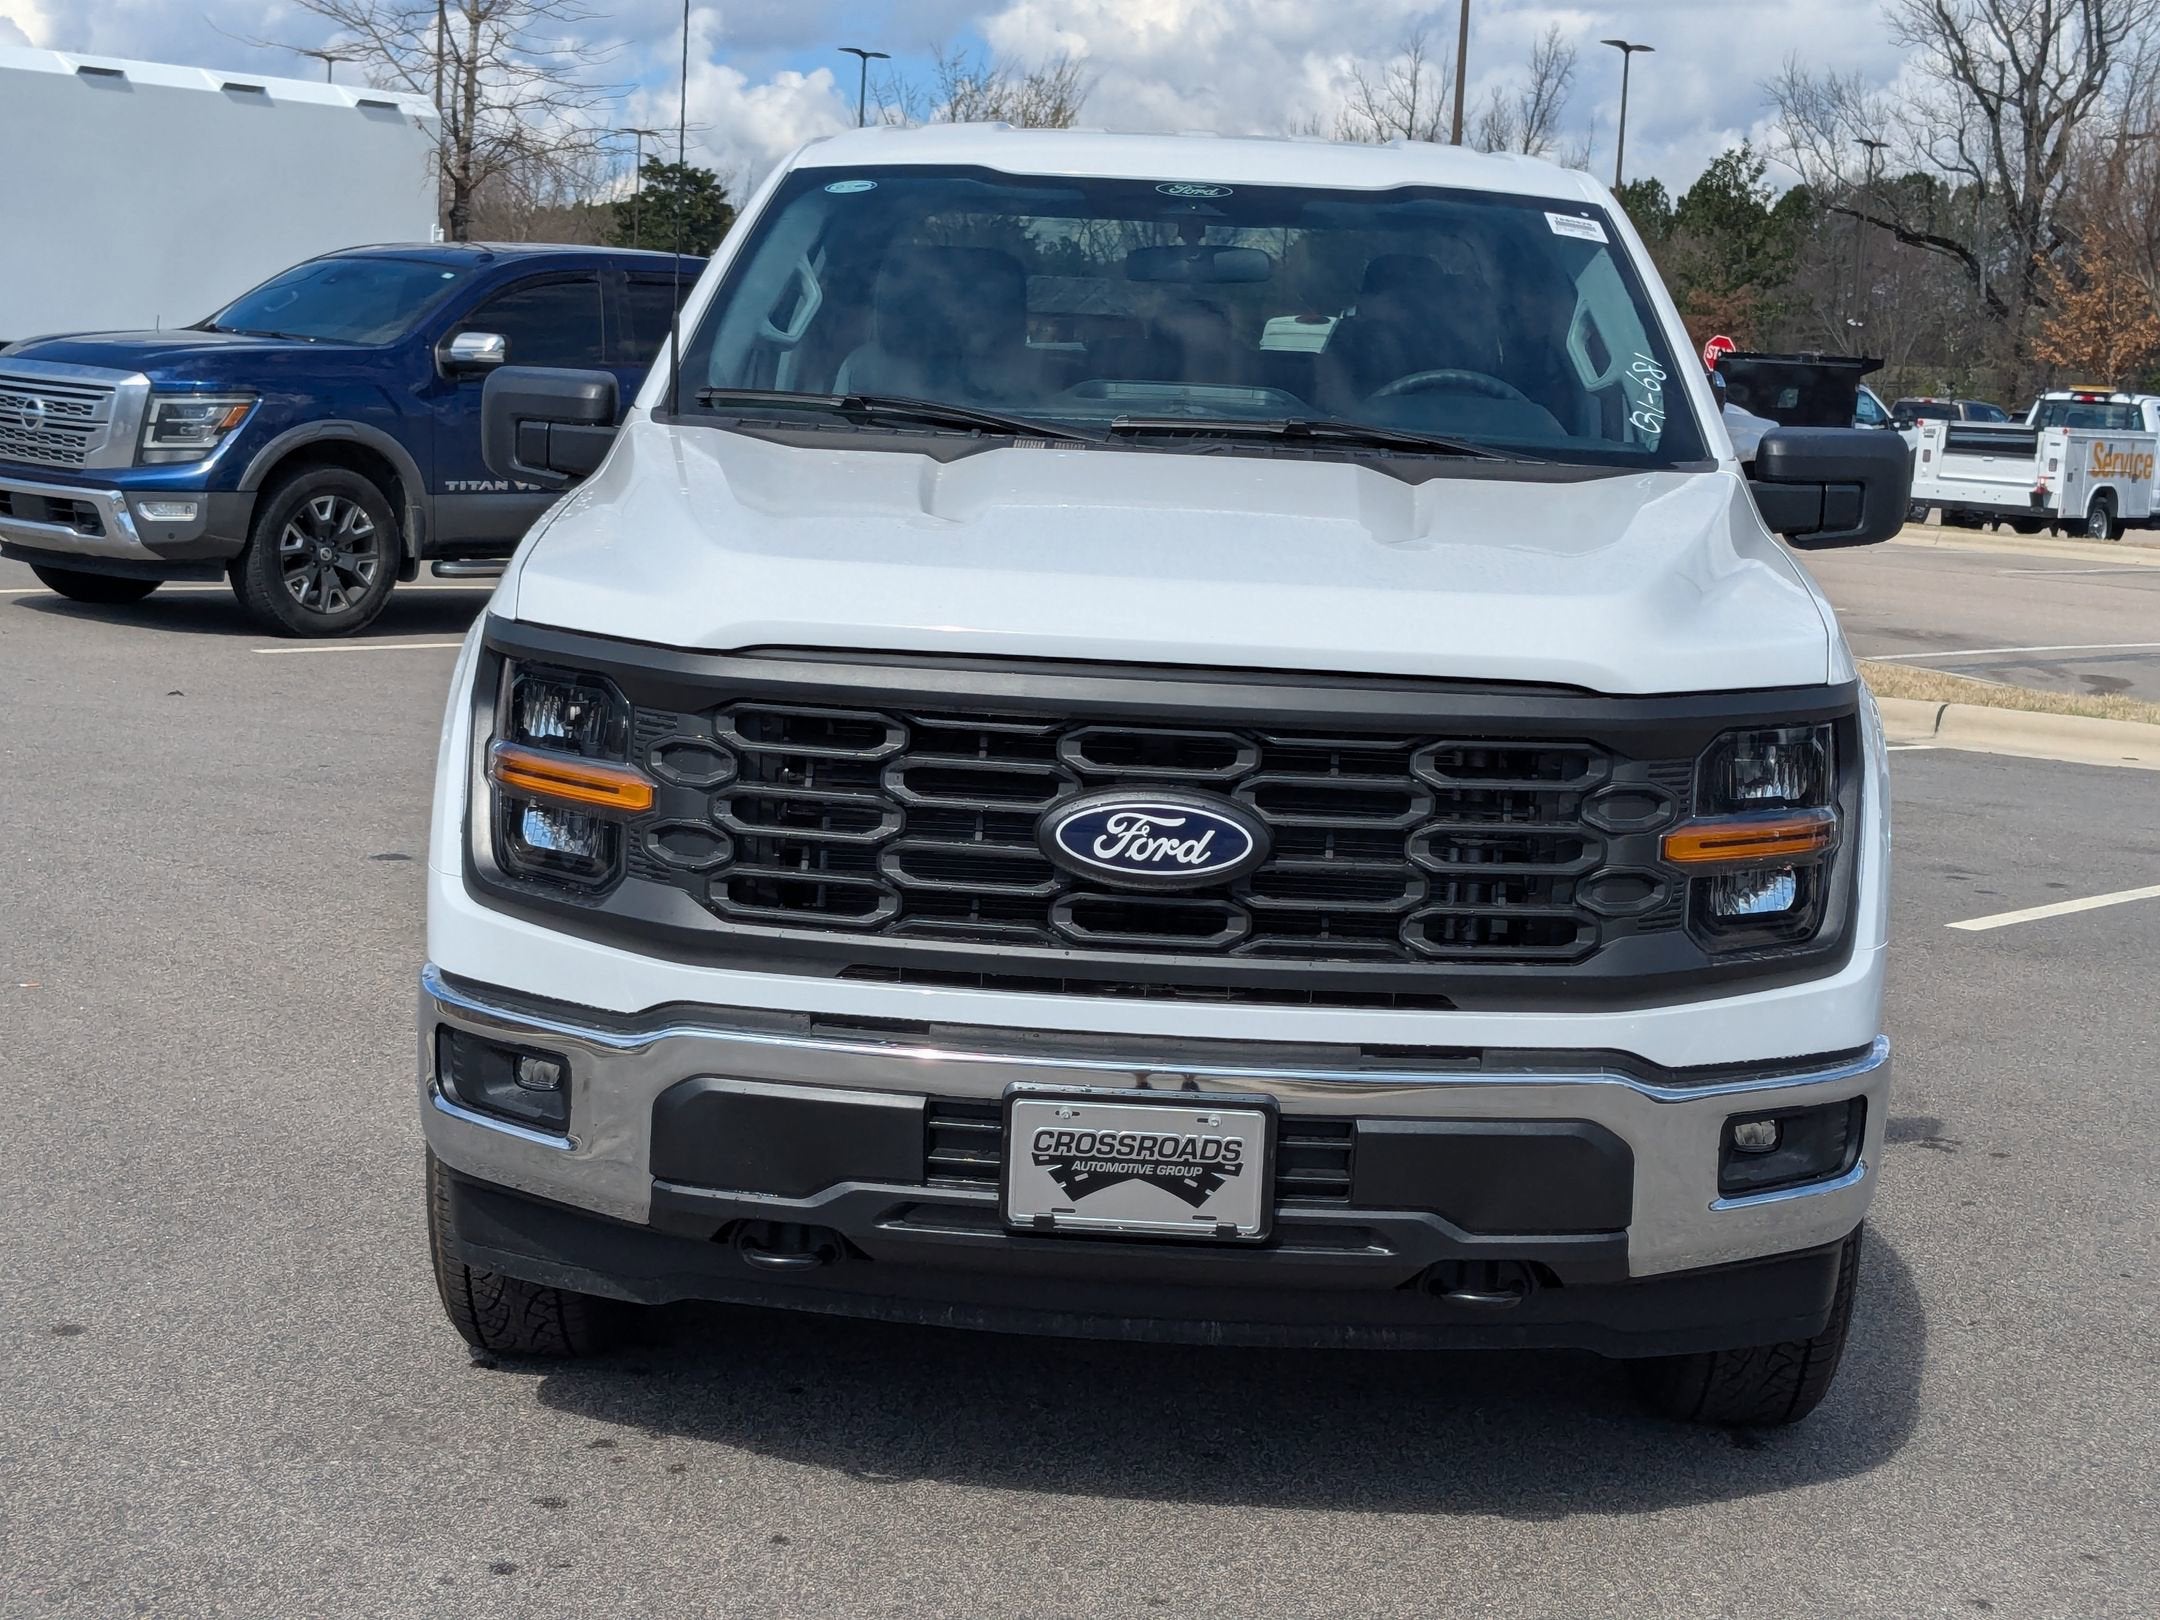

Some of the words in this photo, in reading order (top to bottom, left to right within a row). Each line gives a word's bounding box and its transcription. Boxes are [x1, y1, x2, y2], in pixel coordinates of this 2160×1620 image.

[1168, 184, 1220, 196] Ford
[2090, 441, 2154, 480] Service
[444, 480, 509, 491] TITAN
[1093, 812, 1216, 865] Ford
[1032, 1129, 1244, 1163] CROSSROADS
[1070, 1159, 1155, 1176] AUTOMOTIVE
[1156, 1164, 1203, 1178] GROUP
